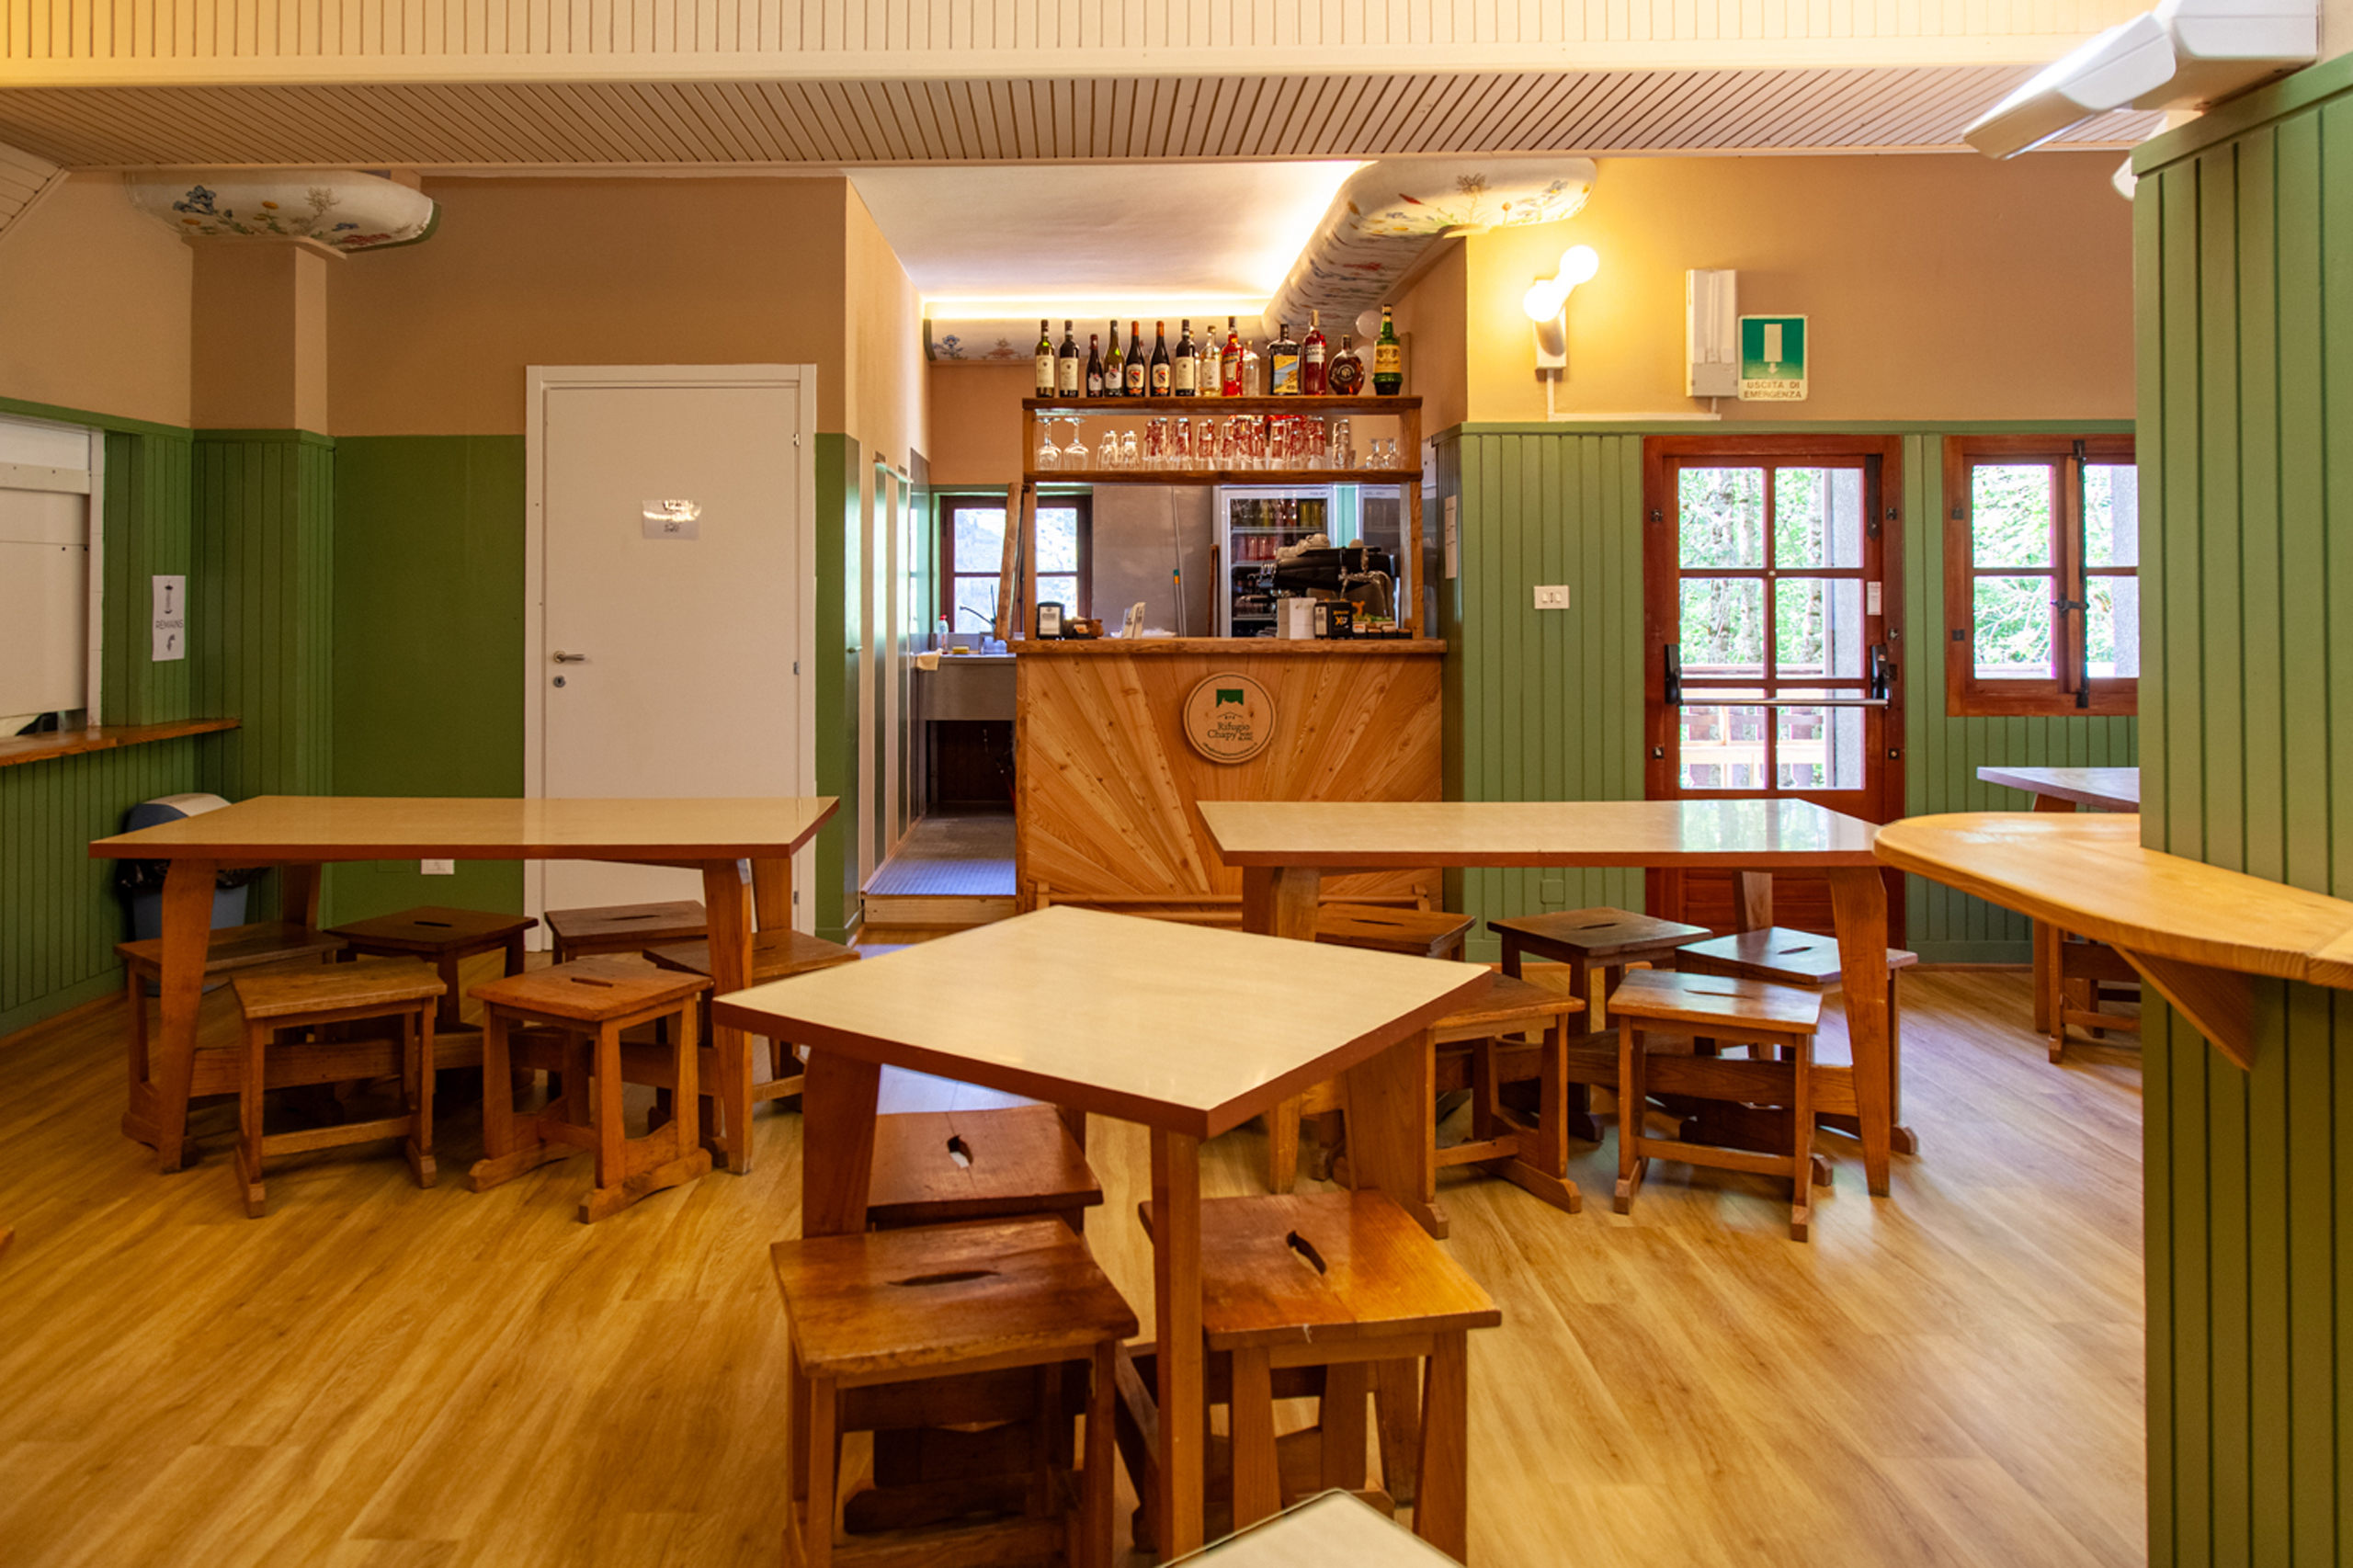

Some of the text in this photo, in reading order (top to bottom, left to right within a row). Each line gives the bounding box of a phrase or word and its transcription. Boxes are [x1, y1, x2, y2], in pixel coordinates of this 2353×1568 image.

[1790, 381, 1800, 389] DI
[155, 619, 184, 630] REMAINS
[1217, 722, 1250, 733] Rifugio
[1207, 729, 1238, 741] Chapy
